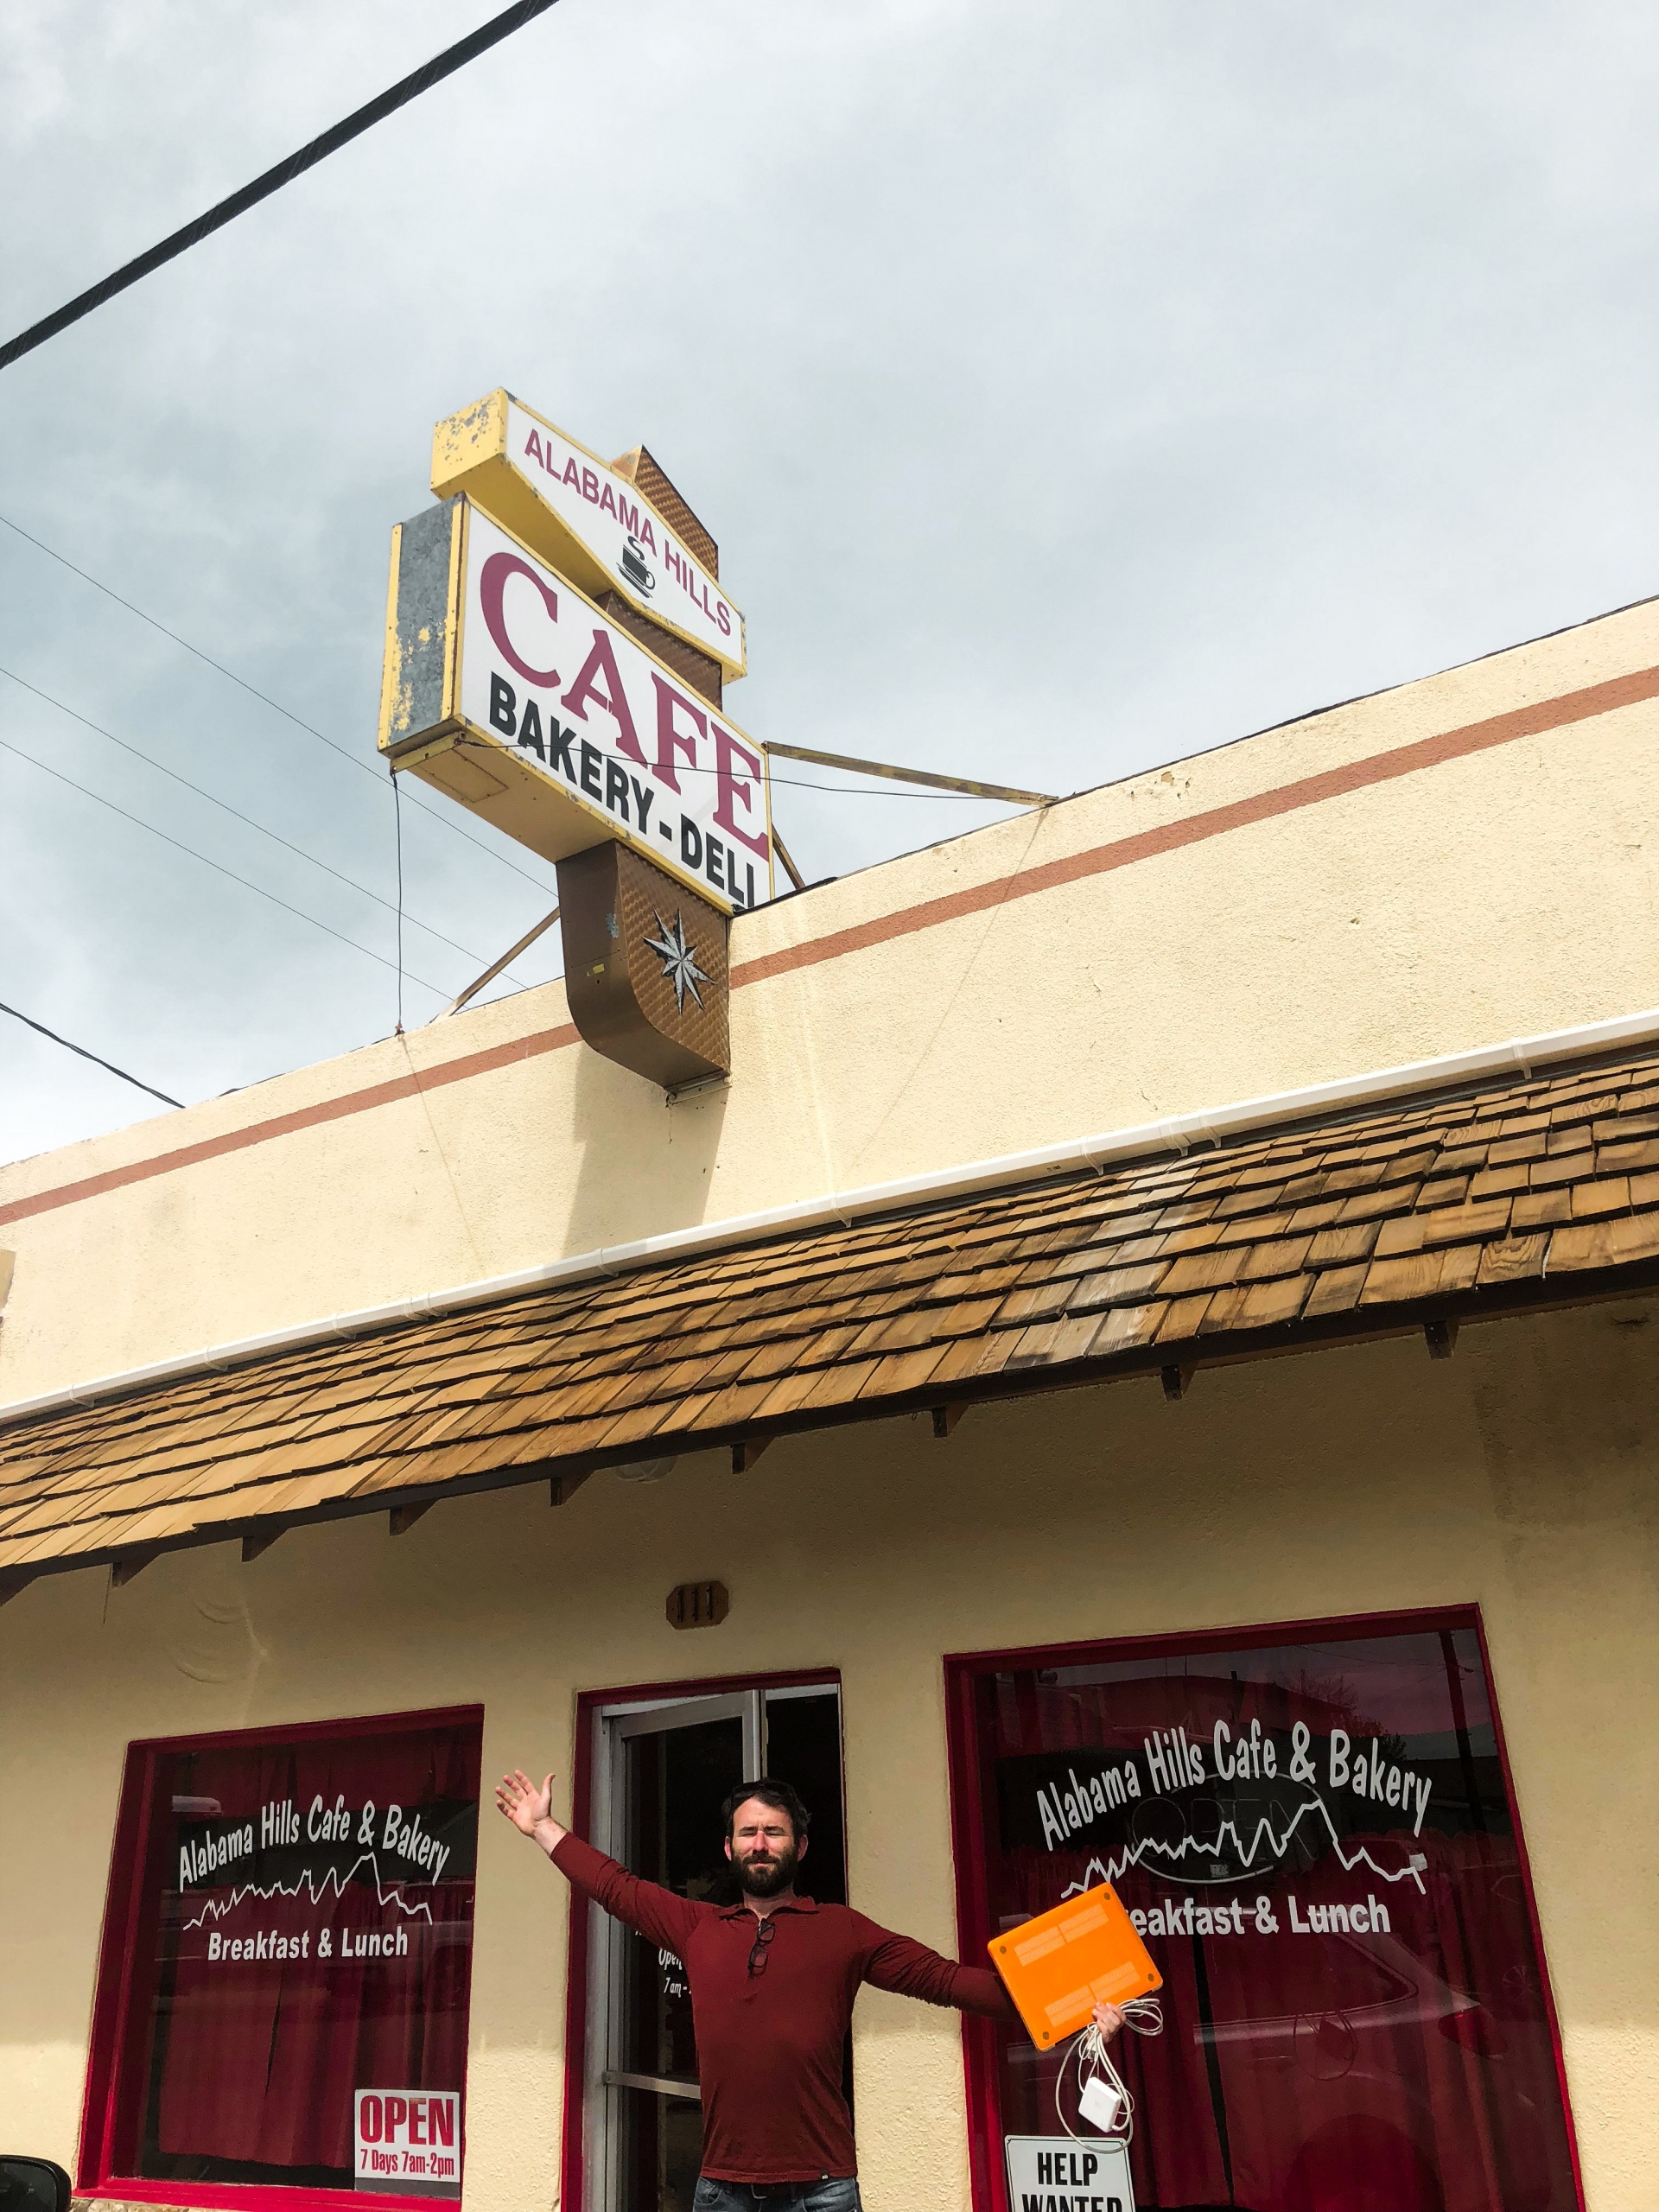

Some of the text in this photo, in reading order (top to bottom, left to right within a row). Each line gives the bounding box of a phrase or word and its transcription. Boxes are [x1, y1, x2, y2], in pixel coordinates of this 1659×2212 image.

[524, 429, 731, 637] ALABAMA HILLS
[480, 551, 769, 862] CAFE
[1036, 1718, 1433, 1851] Alabama Hills Cafe & Bakery
[179, 1794, 450, 1893] Alabama Hills Cafe & Bakery
[1125, 1894, 1391, 1936] eakfast & Lunch
[207, 1926, 408, 1961] Breakfast & Lunch
[359, 2094, 454, 2147] OPEN
[360, 2148, 454, 2178] 7 Days 7am-2pm
[1037, 2152, 1098, 2186] HELP
